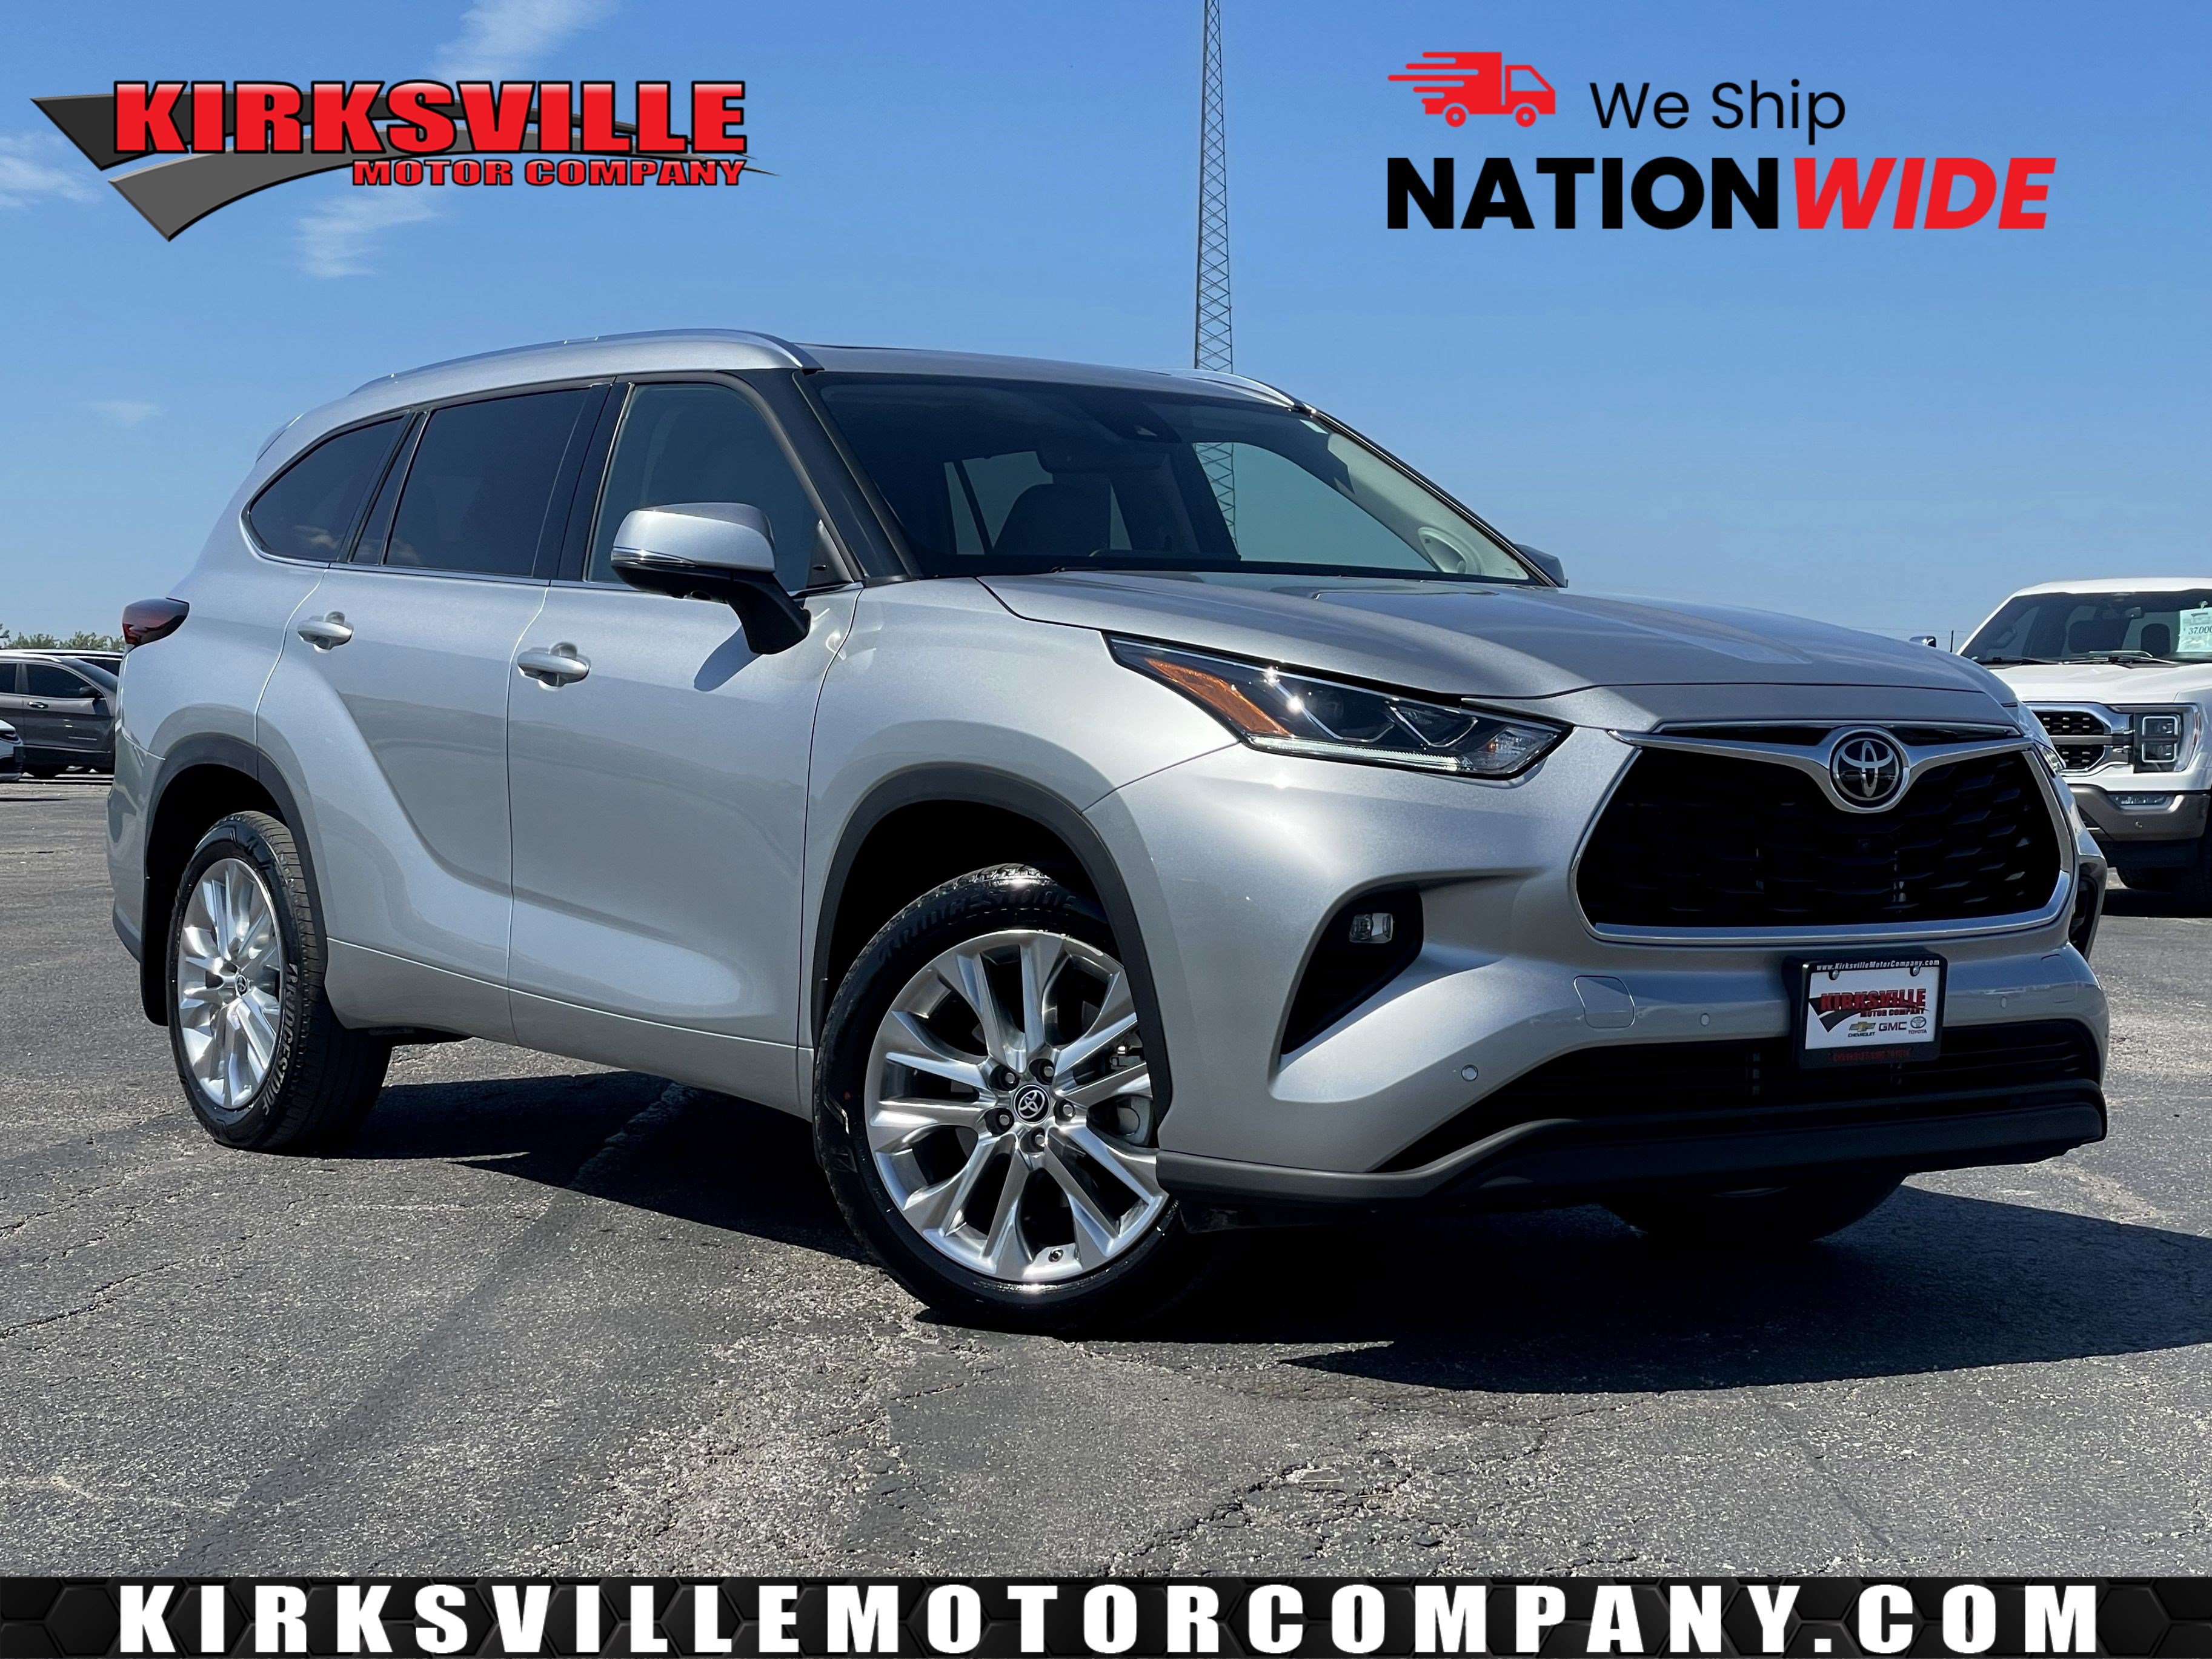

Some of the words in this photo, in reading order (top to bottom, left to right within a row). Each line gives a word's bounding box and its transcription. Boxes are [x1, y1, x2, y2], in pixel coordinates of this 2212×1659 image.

[1816, 960, 1939, 971] www.KirksvilleMotorCompany.com
[1821, 988, 1926, 1011] KIRKSVILLE
[1879, 1022, 1907, 1031] GMC
